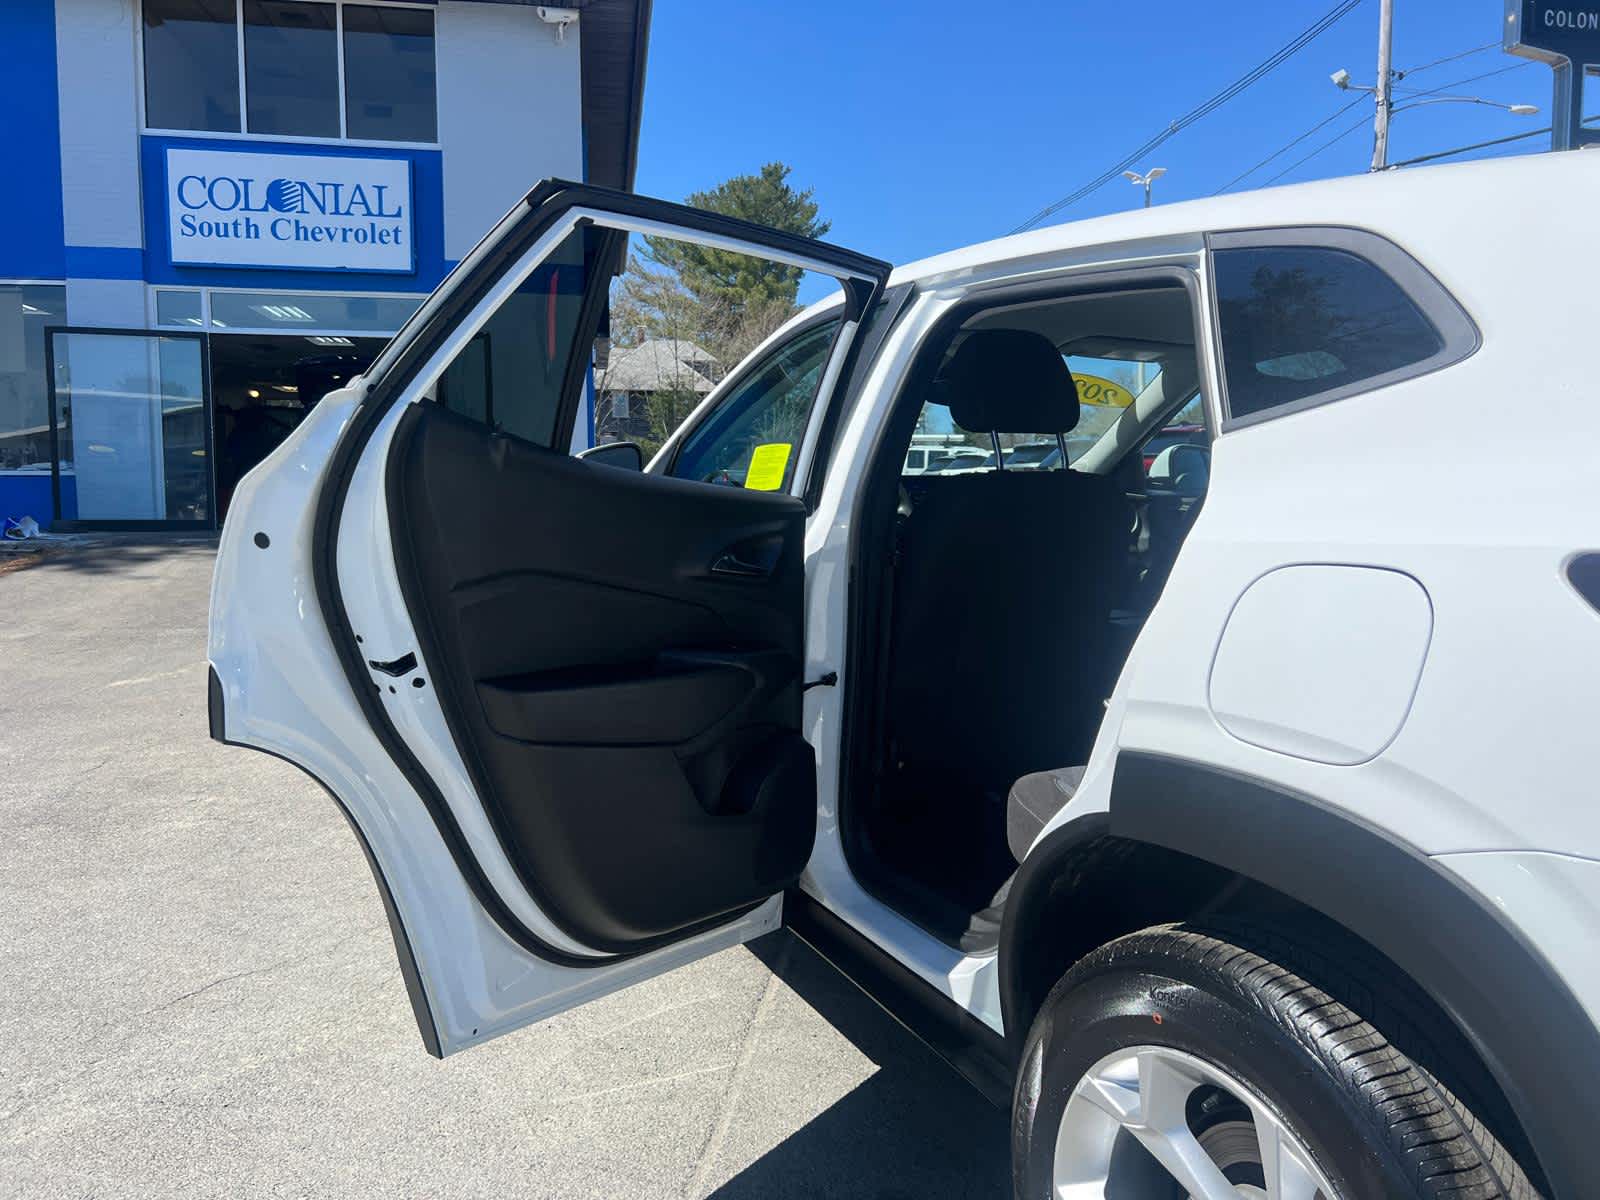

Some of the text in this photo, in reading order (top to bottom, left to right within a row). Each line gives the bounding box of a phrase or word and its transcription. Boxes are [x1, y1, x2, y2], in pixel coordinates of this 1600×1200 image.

[1544, 9, 1599, 29] COLON
[177, 175, 402, 218] COLONIAL
[180, 214, 402, 245] South Chevrolet
